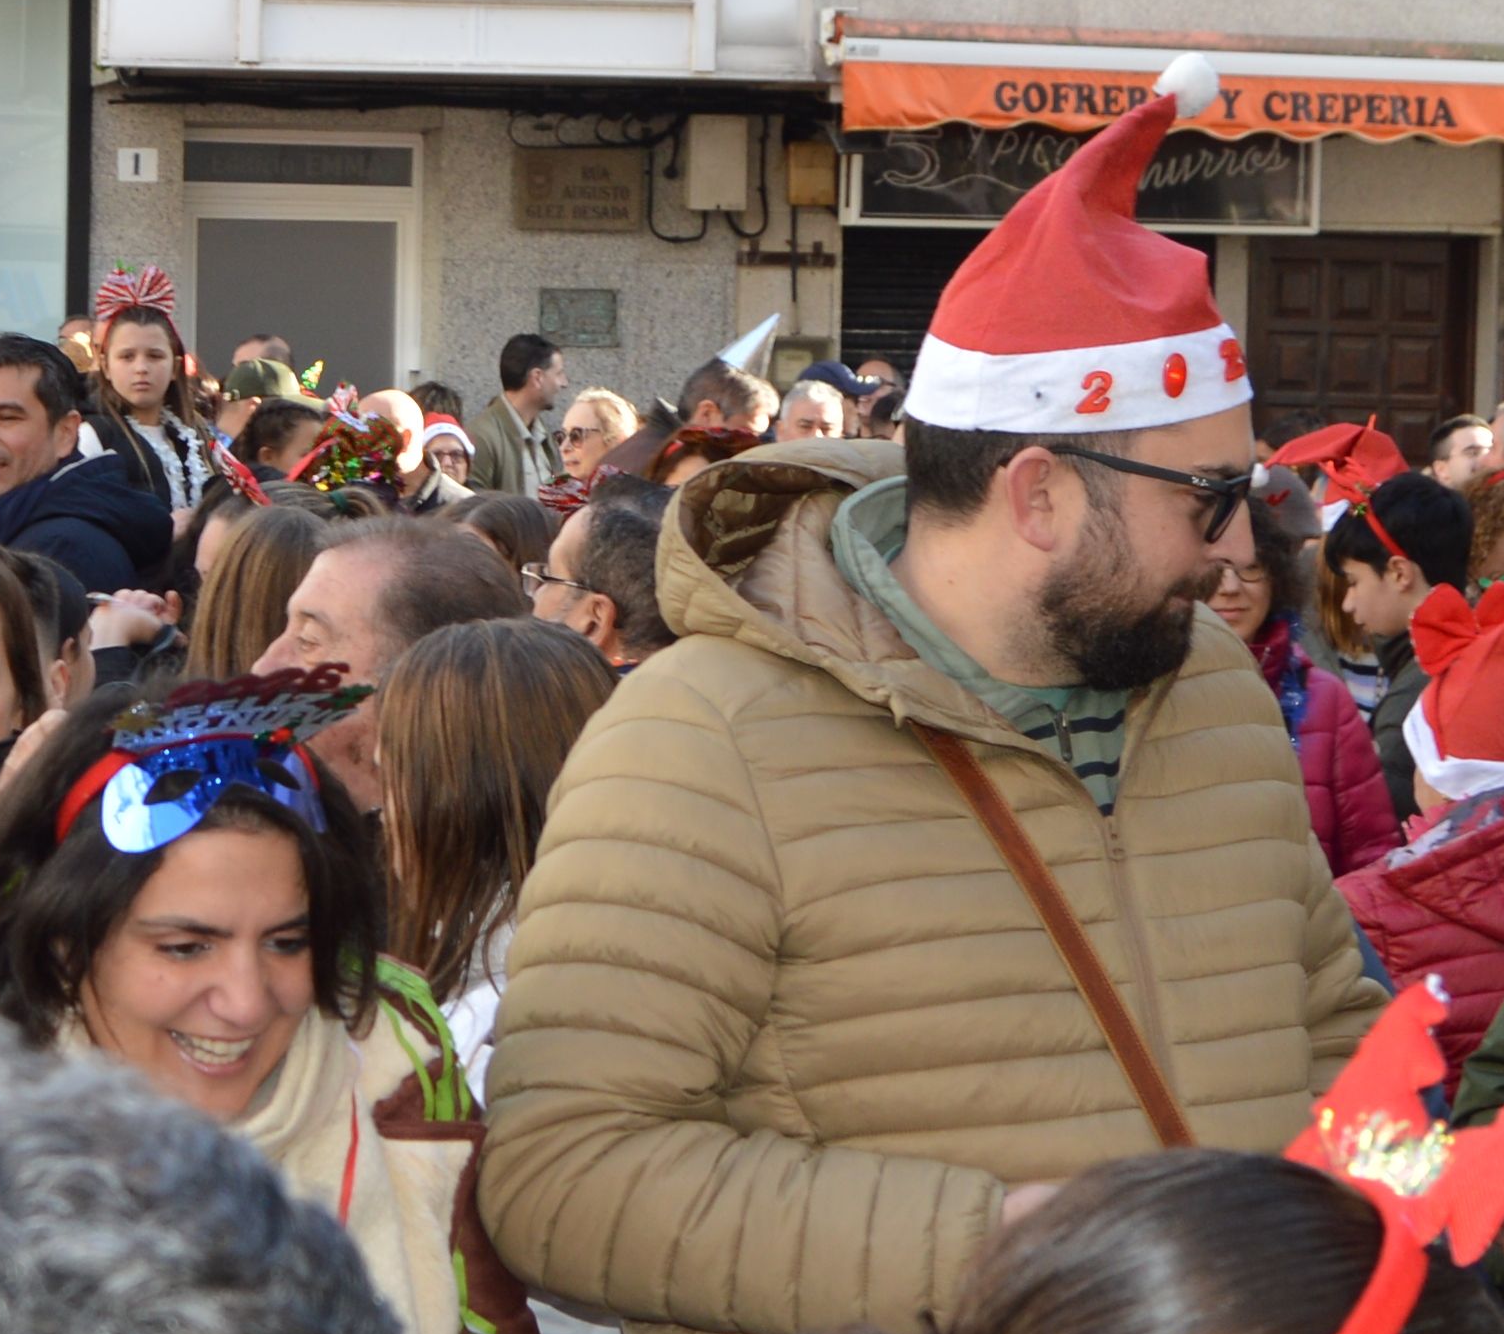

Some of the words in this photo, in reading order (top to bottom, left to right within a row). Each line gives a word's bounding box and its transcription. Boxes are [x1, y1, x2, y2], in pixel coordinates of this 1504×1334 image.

[1218, 88, 1242, 120] Y
[1263, 90, 1457, 128] CREPERIA
[562, 185, 631, 202] AUGUSTO
